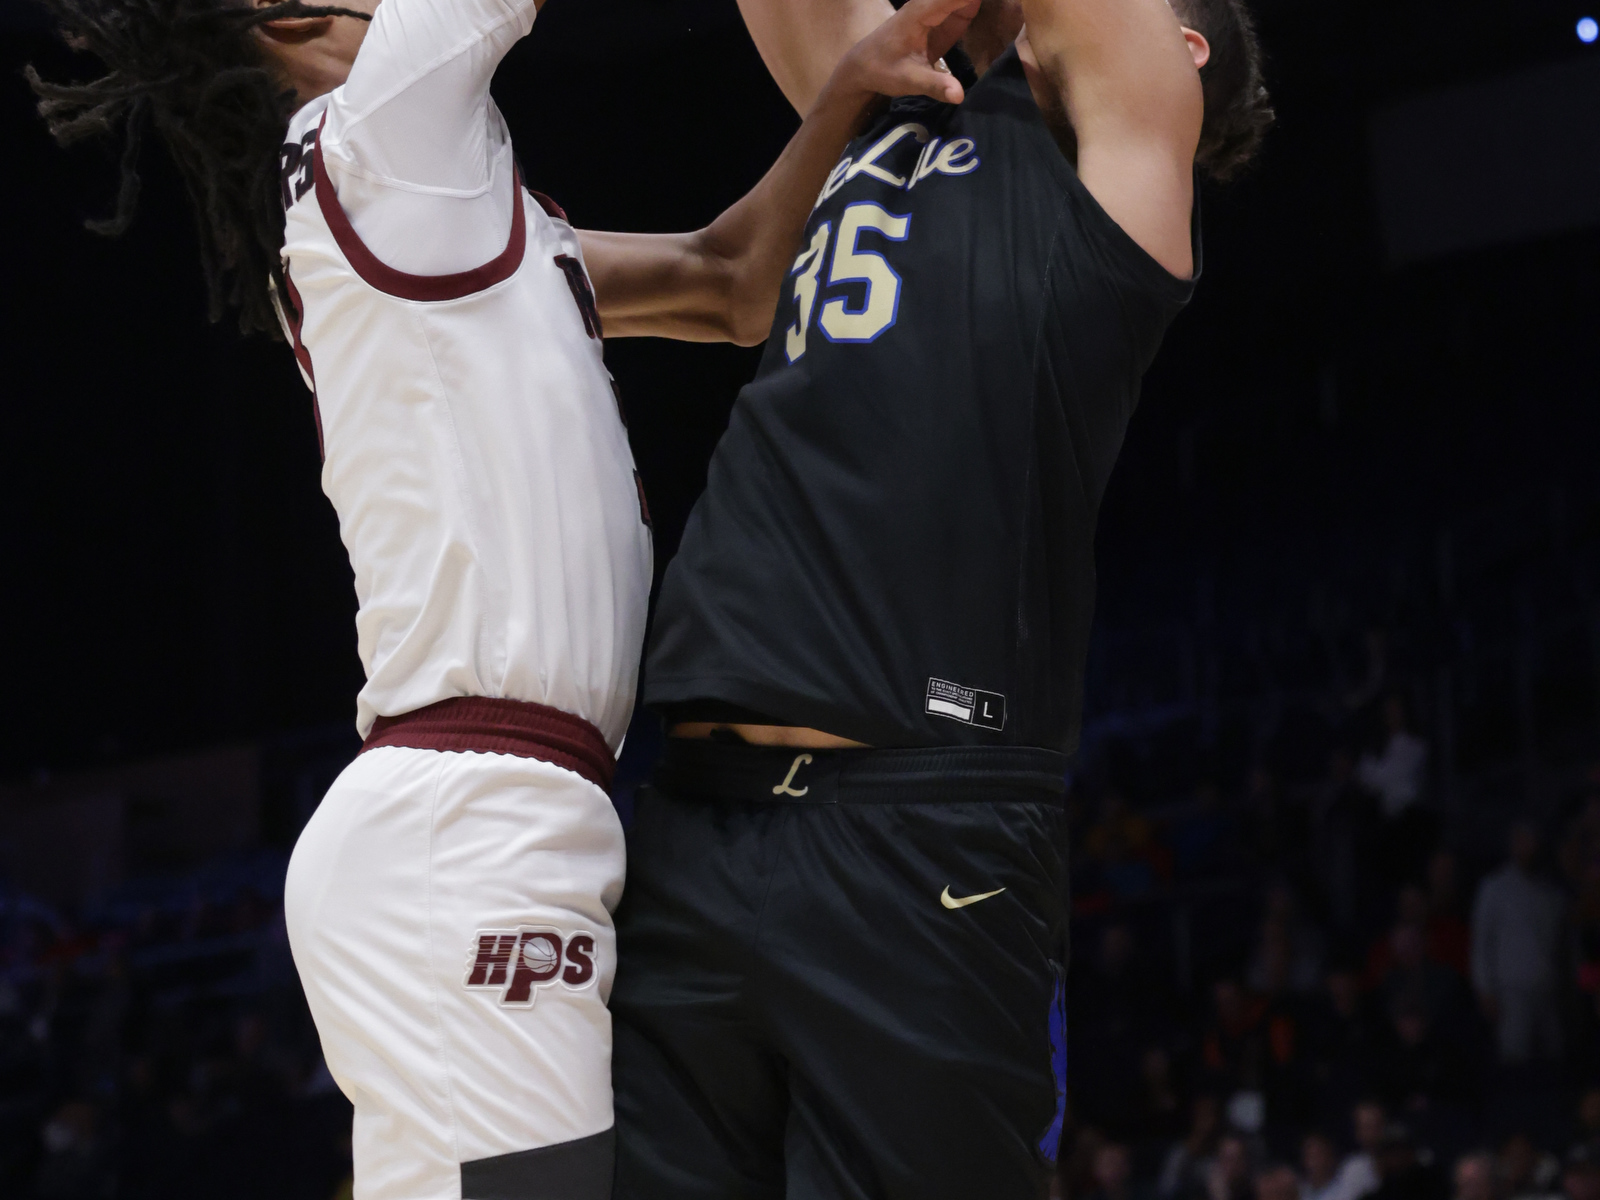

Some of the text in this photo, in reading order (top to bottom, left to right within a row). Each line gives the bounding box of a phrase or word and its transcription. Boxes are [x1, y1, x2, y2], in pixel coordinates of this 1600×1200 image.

[785, 200, 912, 365] 35
[983, 701, 994, 718] L
[467, 931, 595, 1002] HPS
